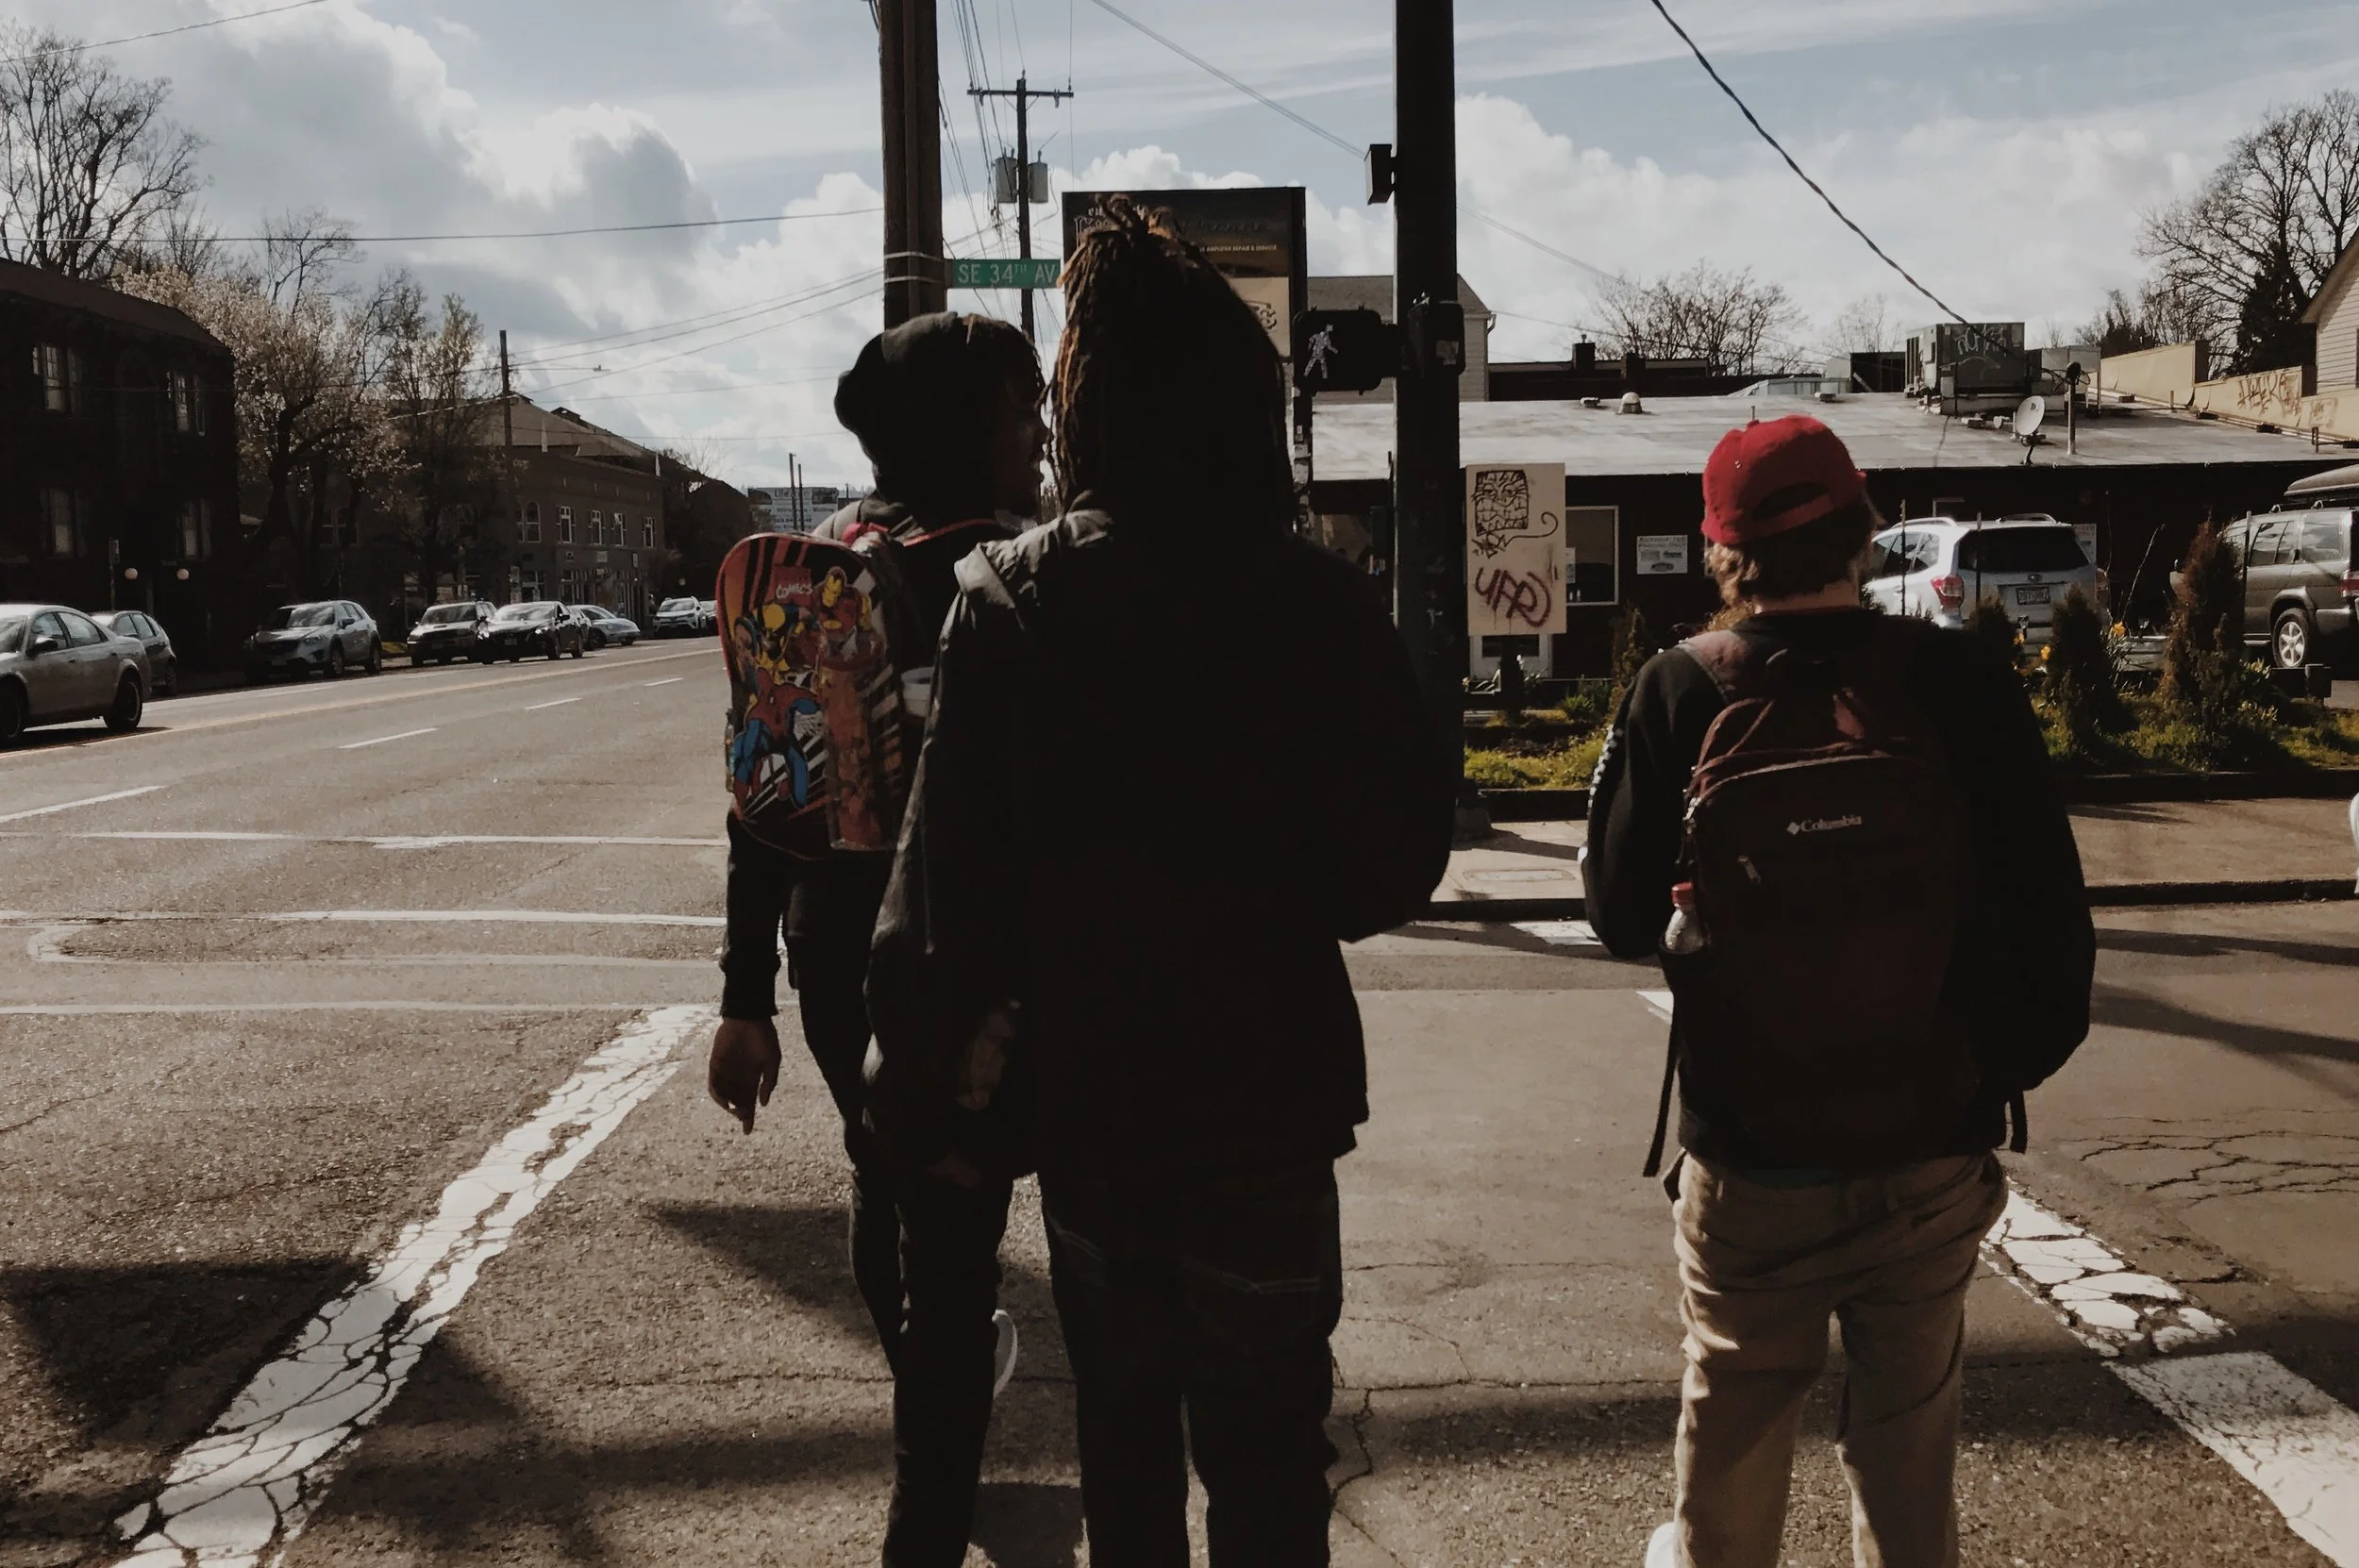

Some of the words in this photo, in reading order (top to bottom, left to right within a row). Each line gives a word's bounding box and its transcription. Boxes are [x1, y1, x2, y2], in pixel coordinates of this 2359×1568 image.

[958, 263, 981, 284] SE
[989, 263, 1028, 284] 34TH
[1034, 263, 1056, 284] AV
[1800, 814, 1863, 832] Columbia
